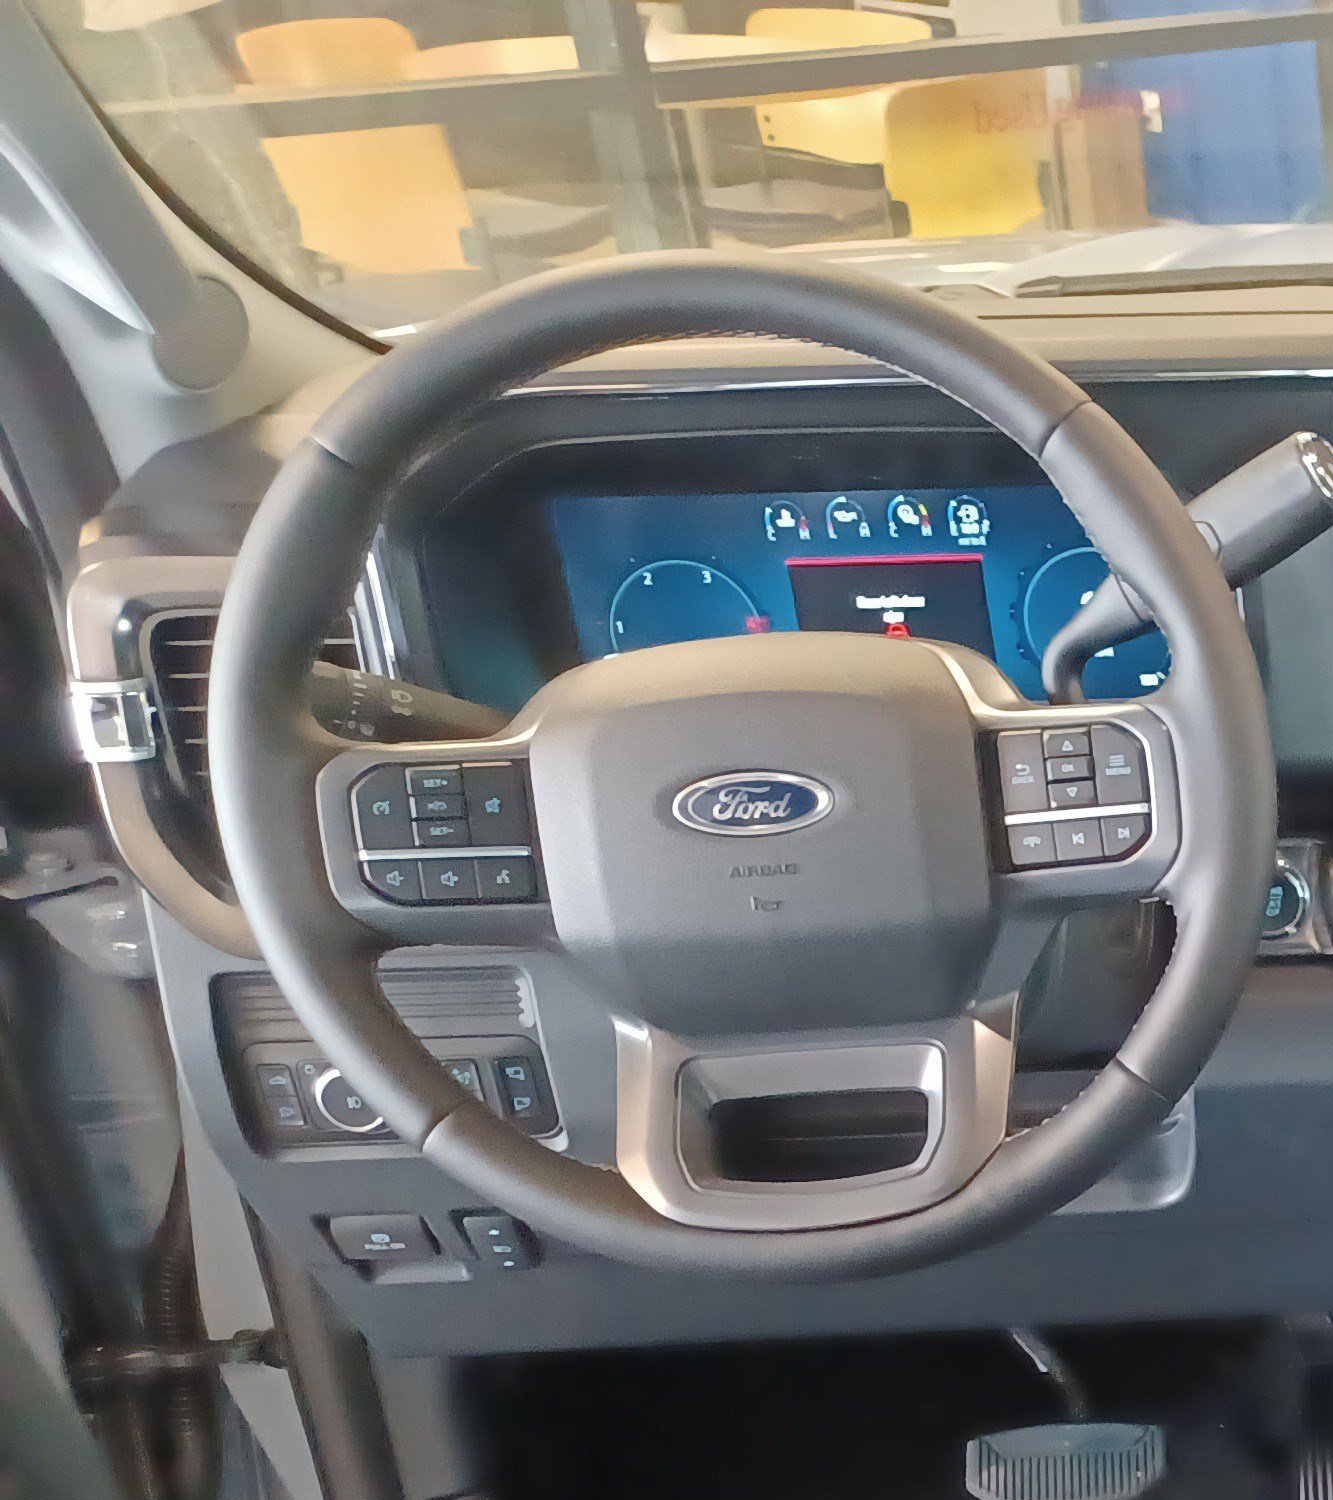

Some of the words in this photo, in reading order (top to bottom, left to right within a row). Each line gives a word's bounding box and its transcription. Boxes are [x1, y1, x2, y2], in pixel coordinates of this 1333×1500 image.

[643, 571, 653, 586] 2
[701, 570, 712, 584] 3
[712, 785, 792, 821] Ford
